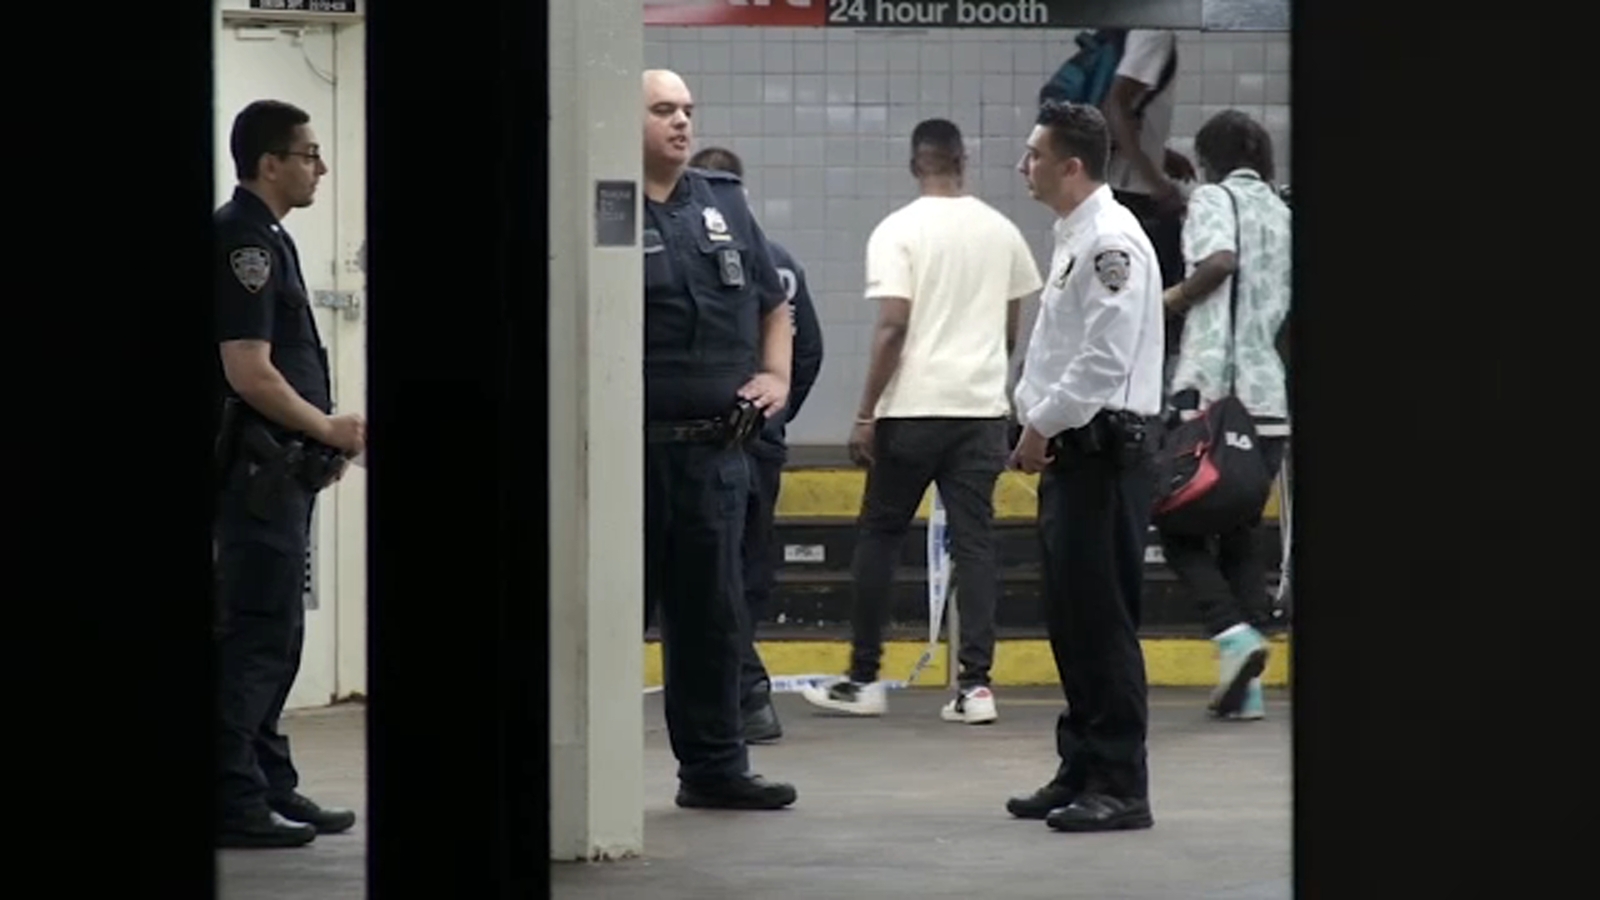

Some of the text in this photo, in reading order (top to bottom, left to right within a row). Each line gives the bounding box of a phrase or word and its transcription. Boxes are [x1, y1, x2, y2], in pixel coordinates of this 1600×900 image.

[829, 0, 1048, 24] 24 hour booth
